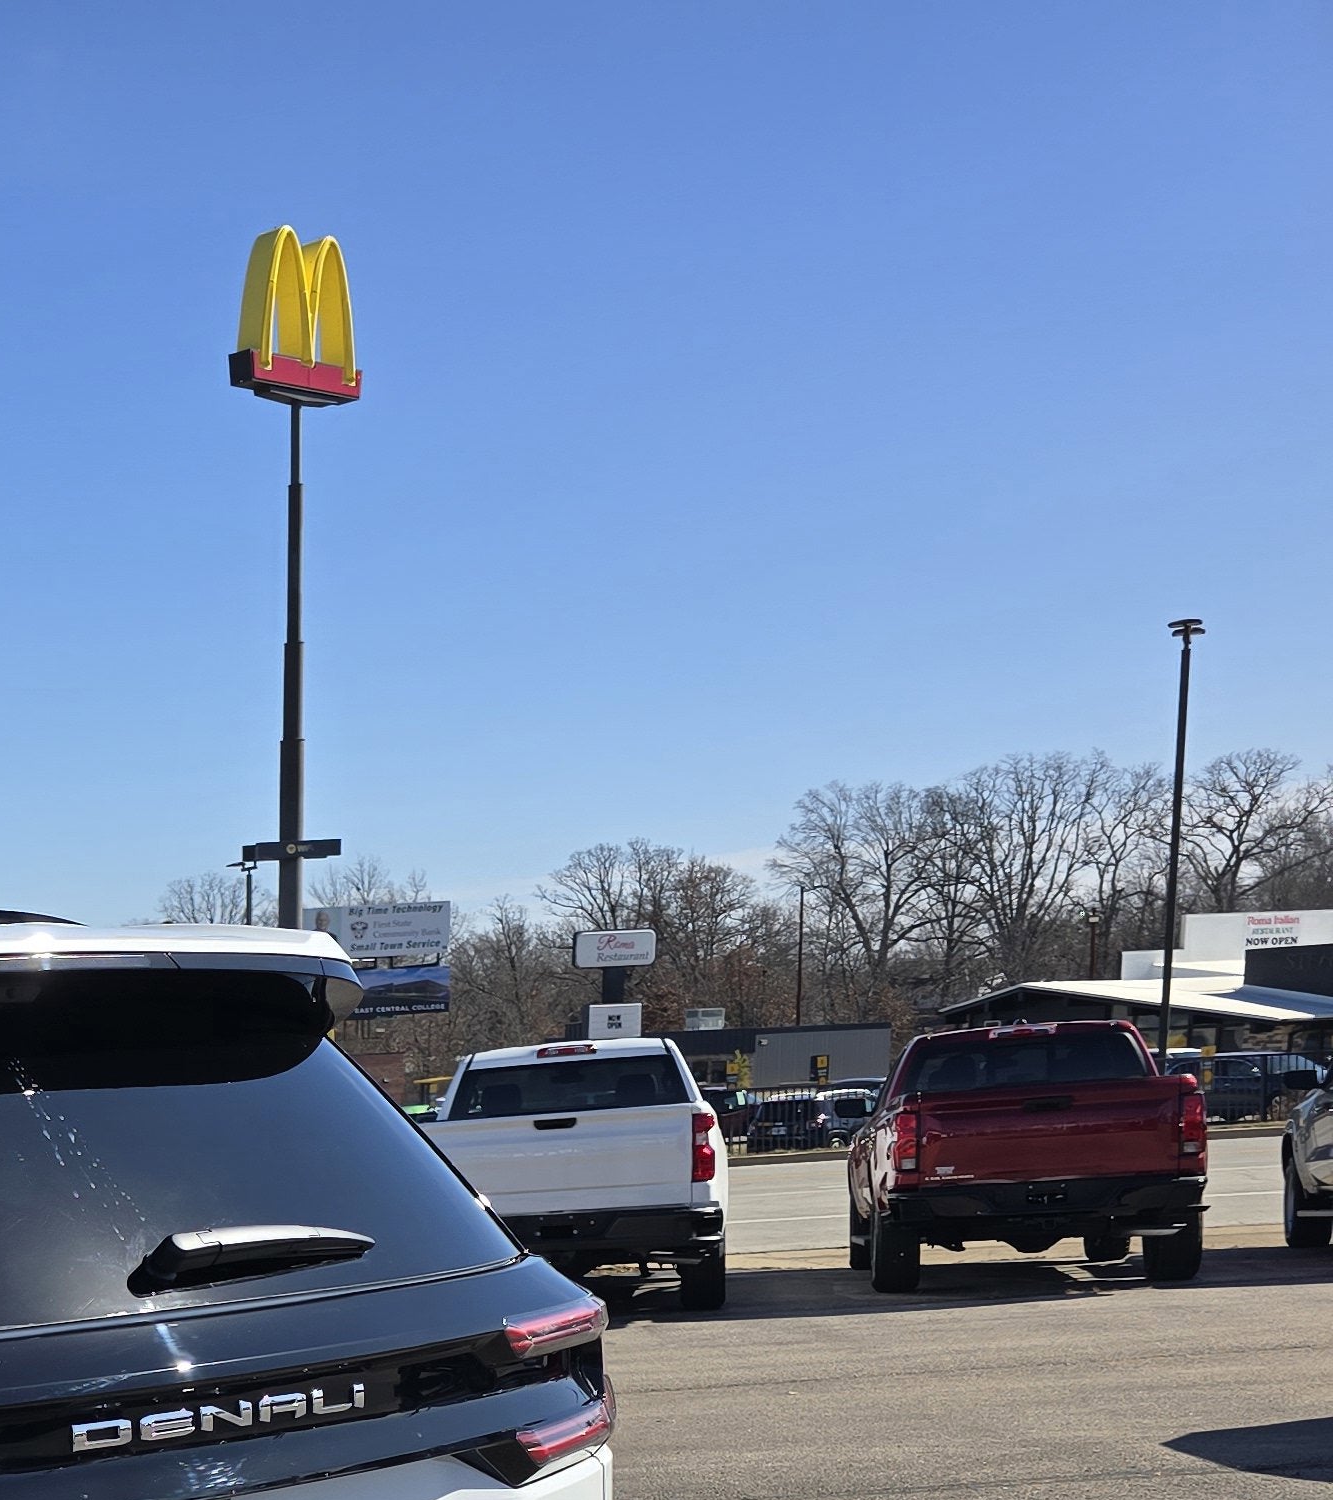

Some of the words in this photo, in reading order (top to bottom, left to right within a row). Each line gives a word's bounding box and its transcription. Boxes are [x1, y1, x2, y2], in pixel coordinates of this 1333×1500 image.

[348, 907, 363, 917] Big
[367, 906, 389, 916] Time
[392, 903, 444, 914] Technology
[373, 921, 391, 929] First
[392, 919, 412, 928] State
[1247, 915, 1272, 925] Roma
[1273, 915, 1300, 925] Italian
[350, 942, 376, 952] Small
[378, 941, 404, 950] Town
[406, 938, 441, 949] Service
[1245, 937, 1269, 946] NOW
[1271, 936, 1299, 946] OPEN
[597, 951, 650, 962] Restaurant
[375, 1005, 410, 1013] CENTRAL
[411, 1003, 446, 1012] COLLEGE
[71, 1383, 365, 1453] DENALI
